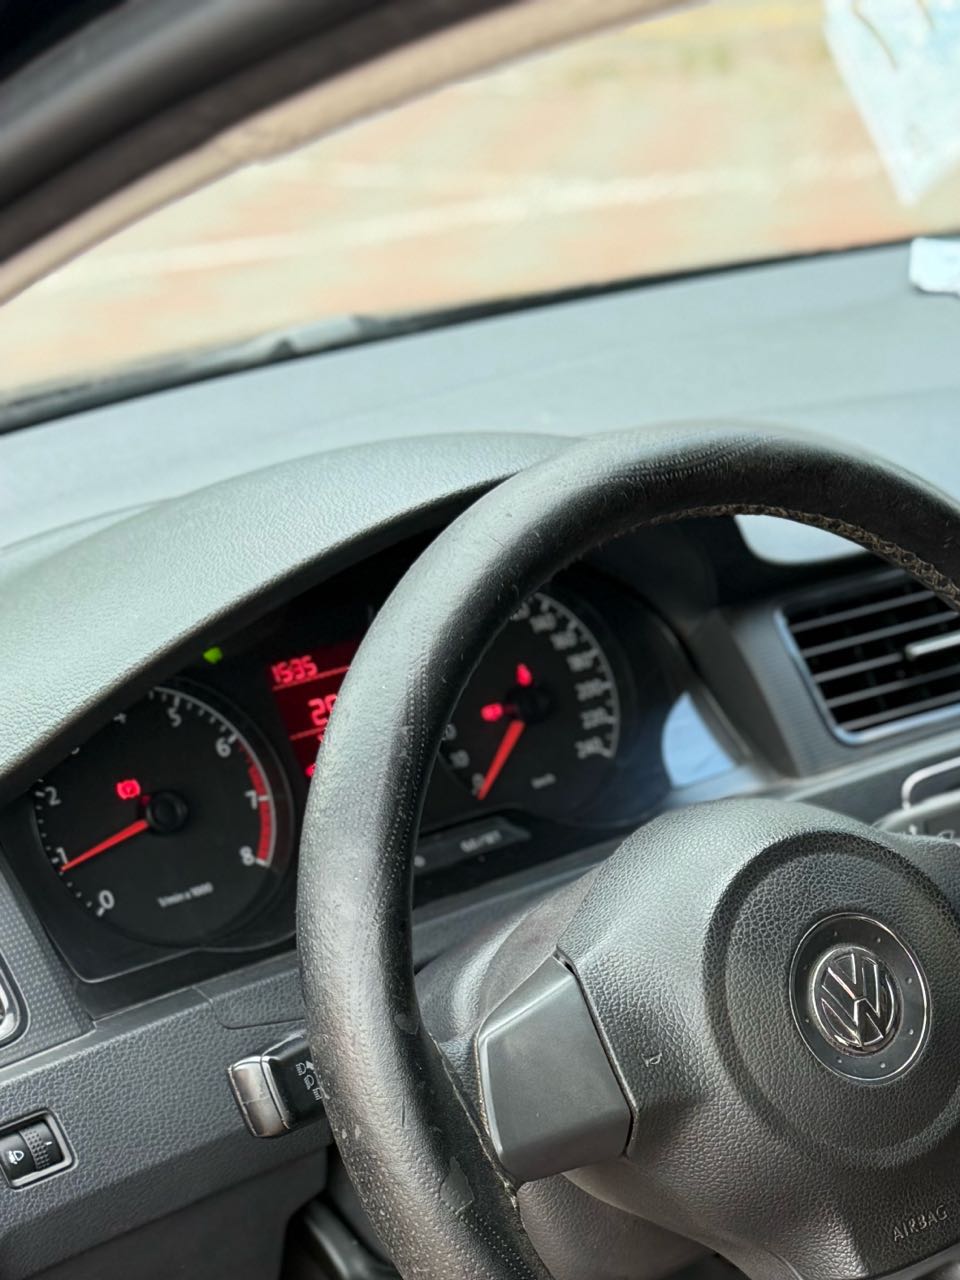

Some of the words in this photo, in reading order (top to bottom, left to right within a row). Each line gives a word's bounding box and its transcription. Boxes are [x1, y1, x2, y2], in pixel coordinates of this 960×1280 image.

[167, 707, 182, 728] 5
[215, 737, 232, 758] 6
[44, 785, 61, 806] 2
[244, 790, 259, 810] 7
[55, 846, 69, 867] 1
[239, 845, 256, 866] 8
[98, 889, 115, 910] 0
[817, 951, 890, 1049] VW
[892, 1203, 948, 1242] AIRBAG
